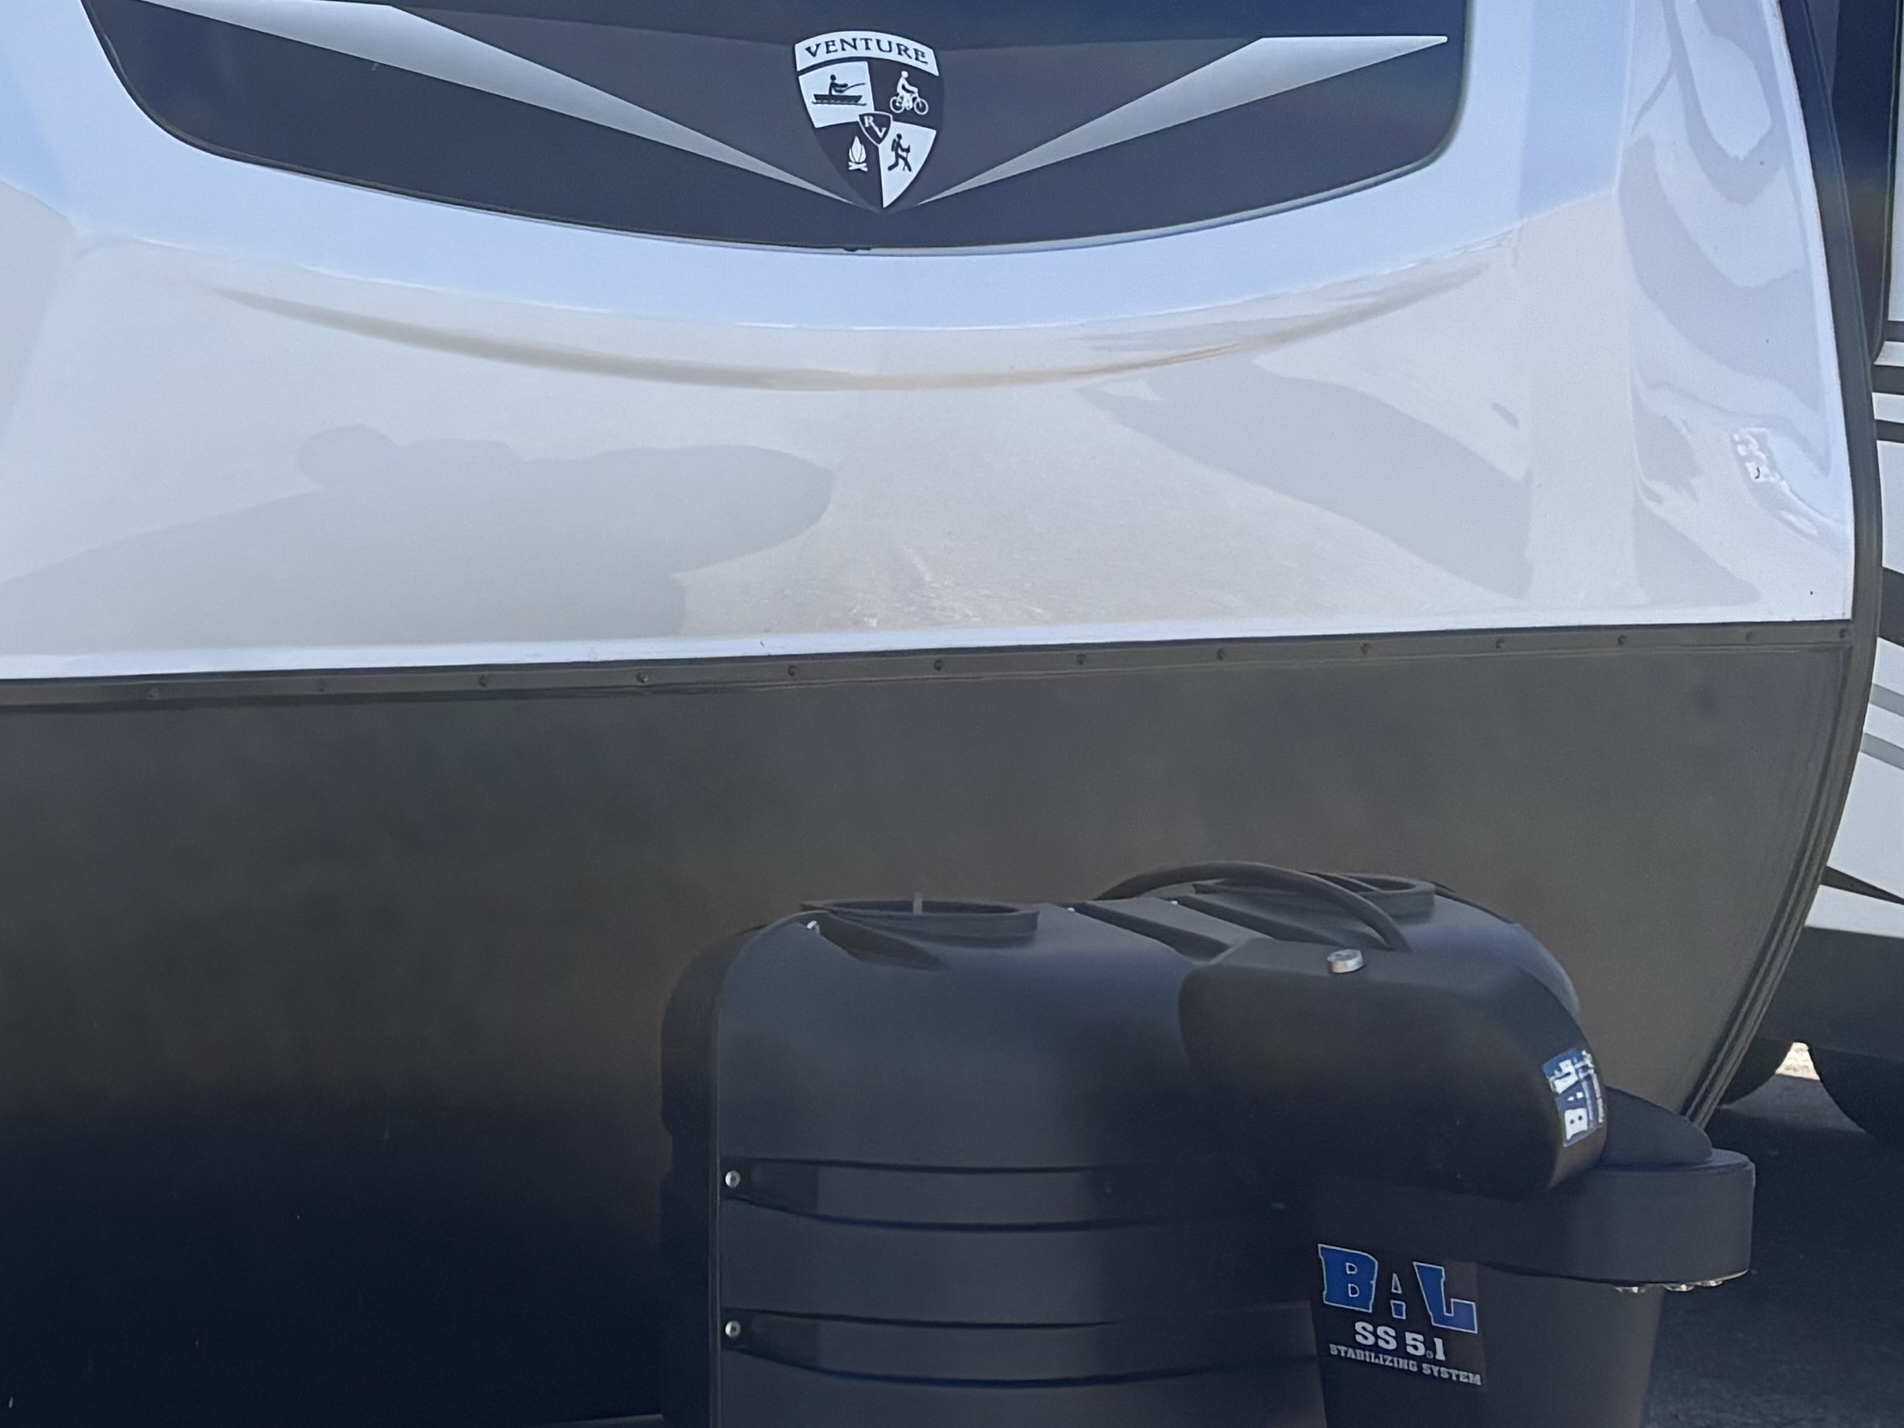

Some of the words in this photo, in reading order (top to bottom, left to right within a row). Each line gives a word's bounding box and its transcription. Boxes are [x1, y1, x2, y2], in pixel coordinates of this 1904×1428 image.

[804, 37, 930, 65] VENTURE
[1318, 1243, 1478, 1335] BAL
[1354, 1321, 1398, 1351] SS
[1405, 1331, 1446, 1361] 5.1
[1329, 1343, 1418, 1372] STABILIZING
[1422, 1362, 1482, 1387] SYSTEM
